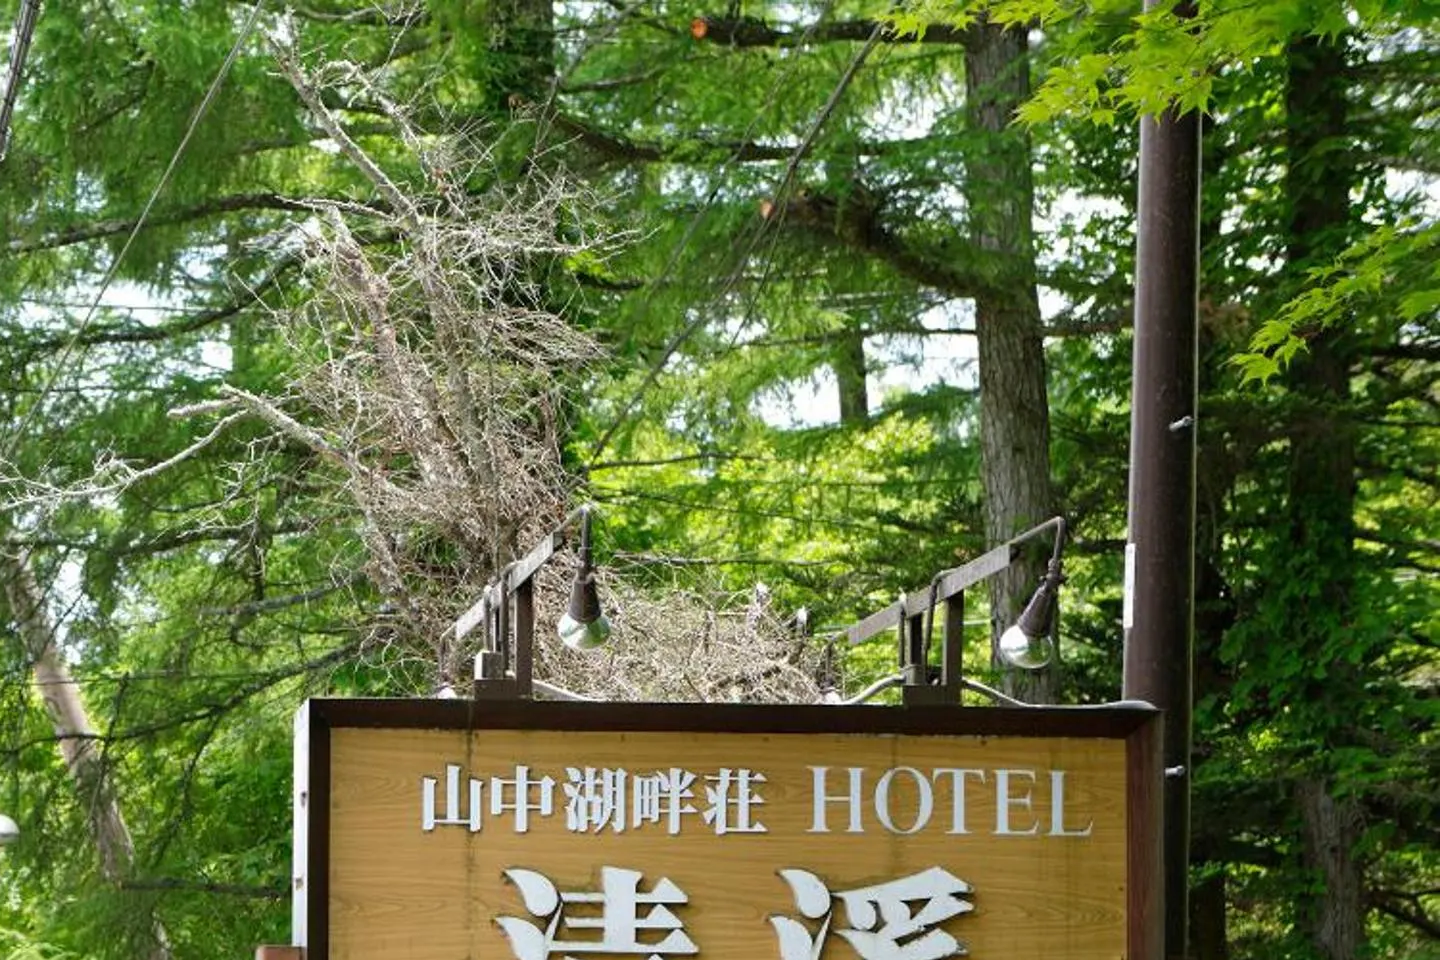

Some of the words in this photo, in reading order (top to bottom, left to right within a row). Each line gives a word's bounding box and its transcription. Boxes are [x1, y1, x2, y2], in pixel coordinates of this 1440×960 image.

[421, 763, 768, 837] 山中湖畔荘
[806, 764, 1095, 839] HOTEL
